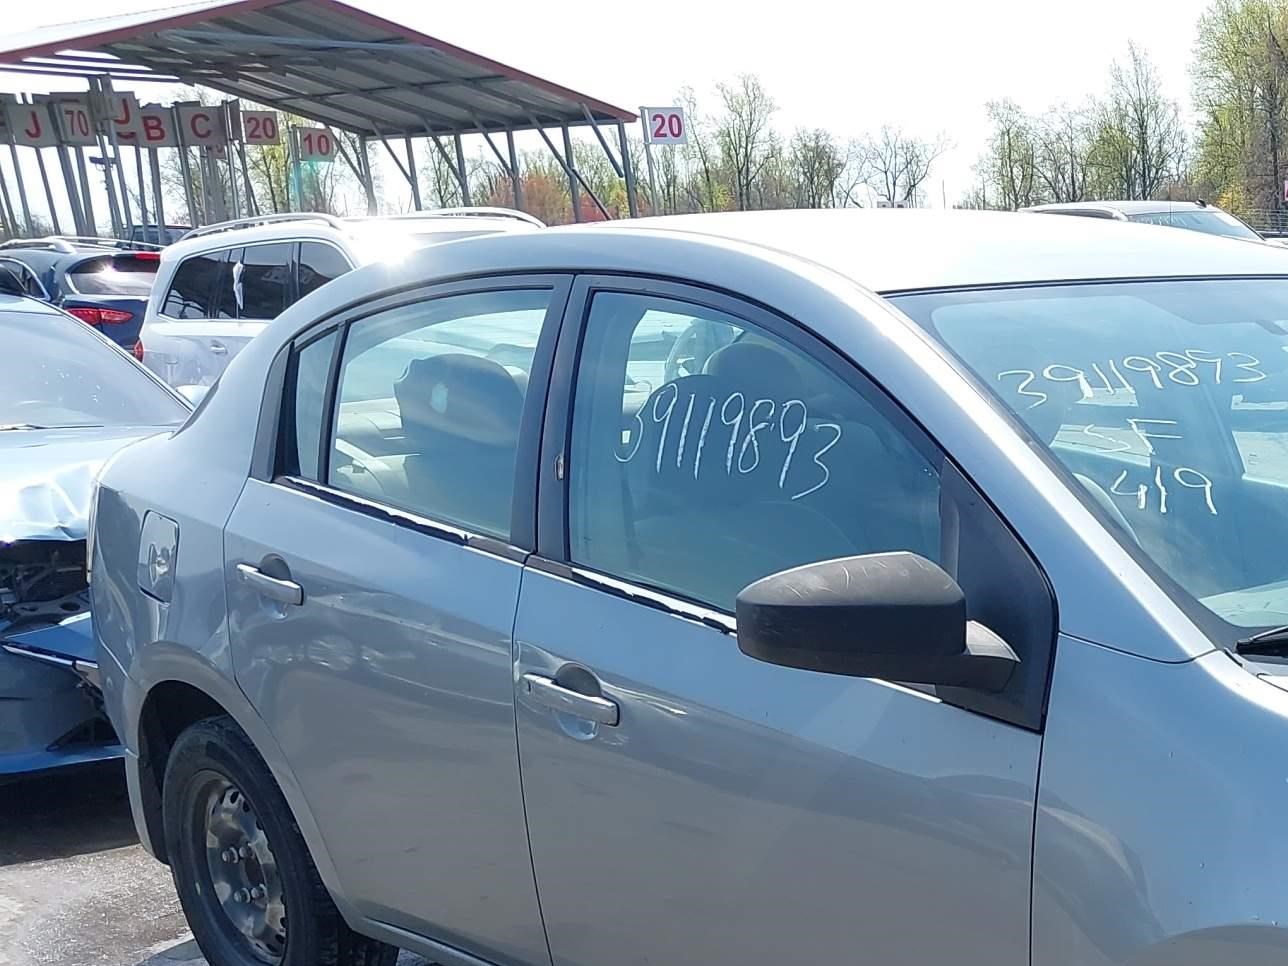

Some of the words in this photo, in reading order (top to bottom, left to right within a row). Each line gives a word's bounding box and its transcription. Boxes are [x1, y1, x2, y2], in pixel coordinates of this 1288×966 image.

[25, 111, 42, 138] J
[64, 110, 89, 136] 70
[141, 115, 165, 141] B
[190, 112, 212, 138] C
[246, 116, 277, 140] 20
[651, 114, 683, 137] 20
[303, 133, 331, 156] 10
[999, 349, 1267, 408] 39119893
[614, 382, 842, 500] 39119893
